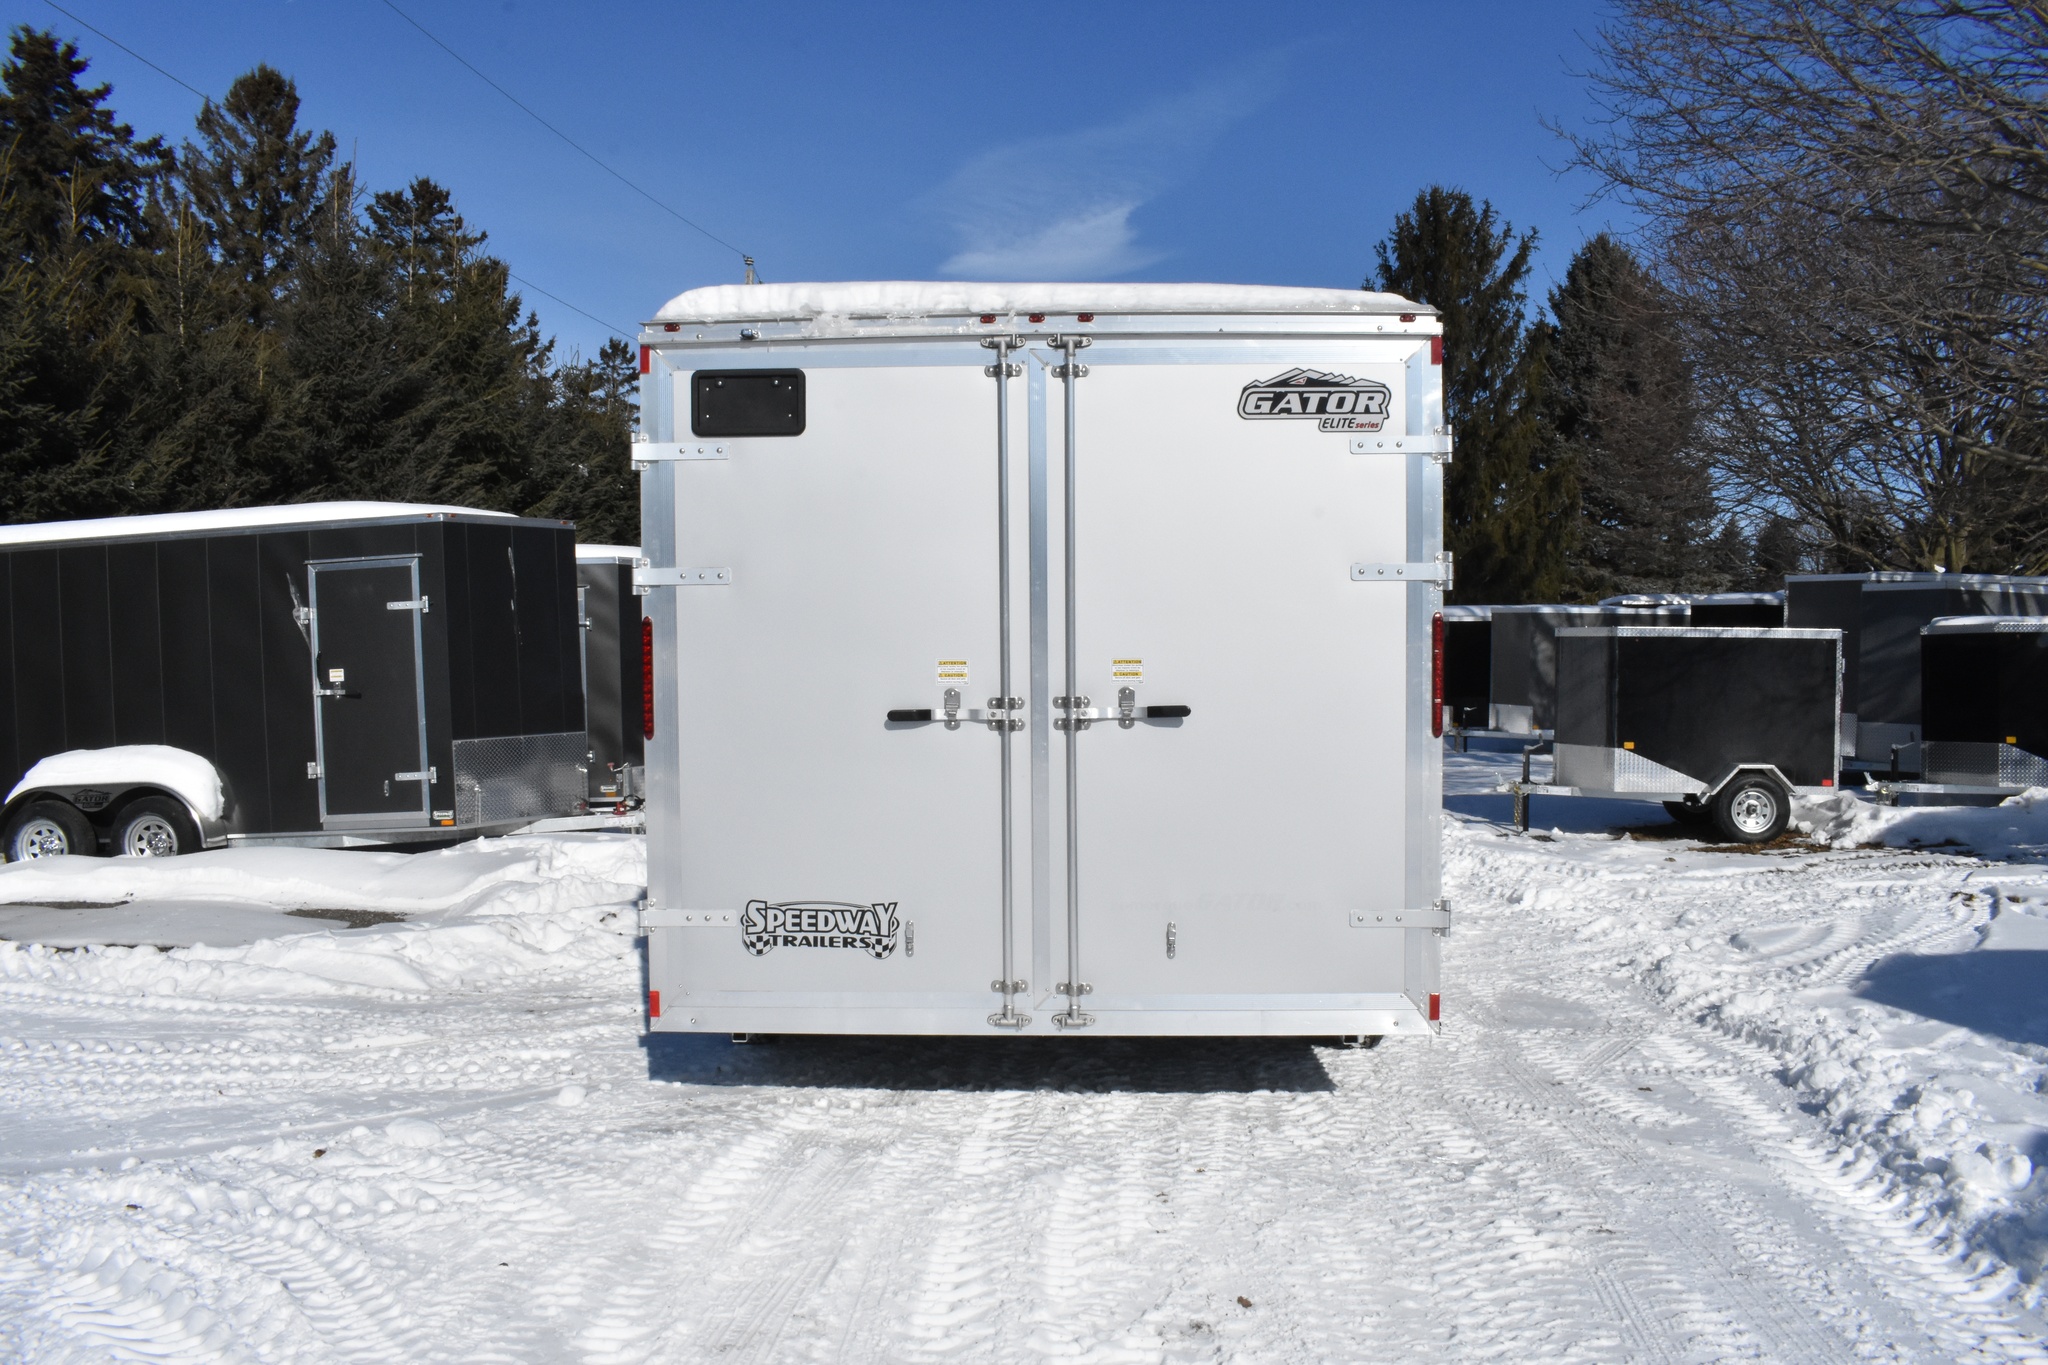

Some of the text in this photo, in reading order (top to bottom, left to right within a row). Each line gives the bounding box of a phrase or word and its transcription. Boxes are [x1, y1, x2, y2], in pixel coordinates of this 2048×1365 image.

[1243, 391, 1386, 415] GATOR
[1322, 418, 1356, 429] ELITE
[745, 899, 898, 938] SPEEDWAY
[768, 935, 872, 949] TRAILERS
